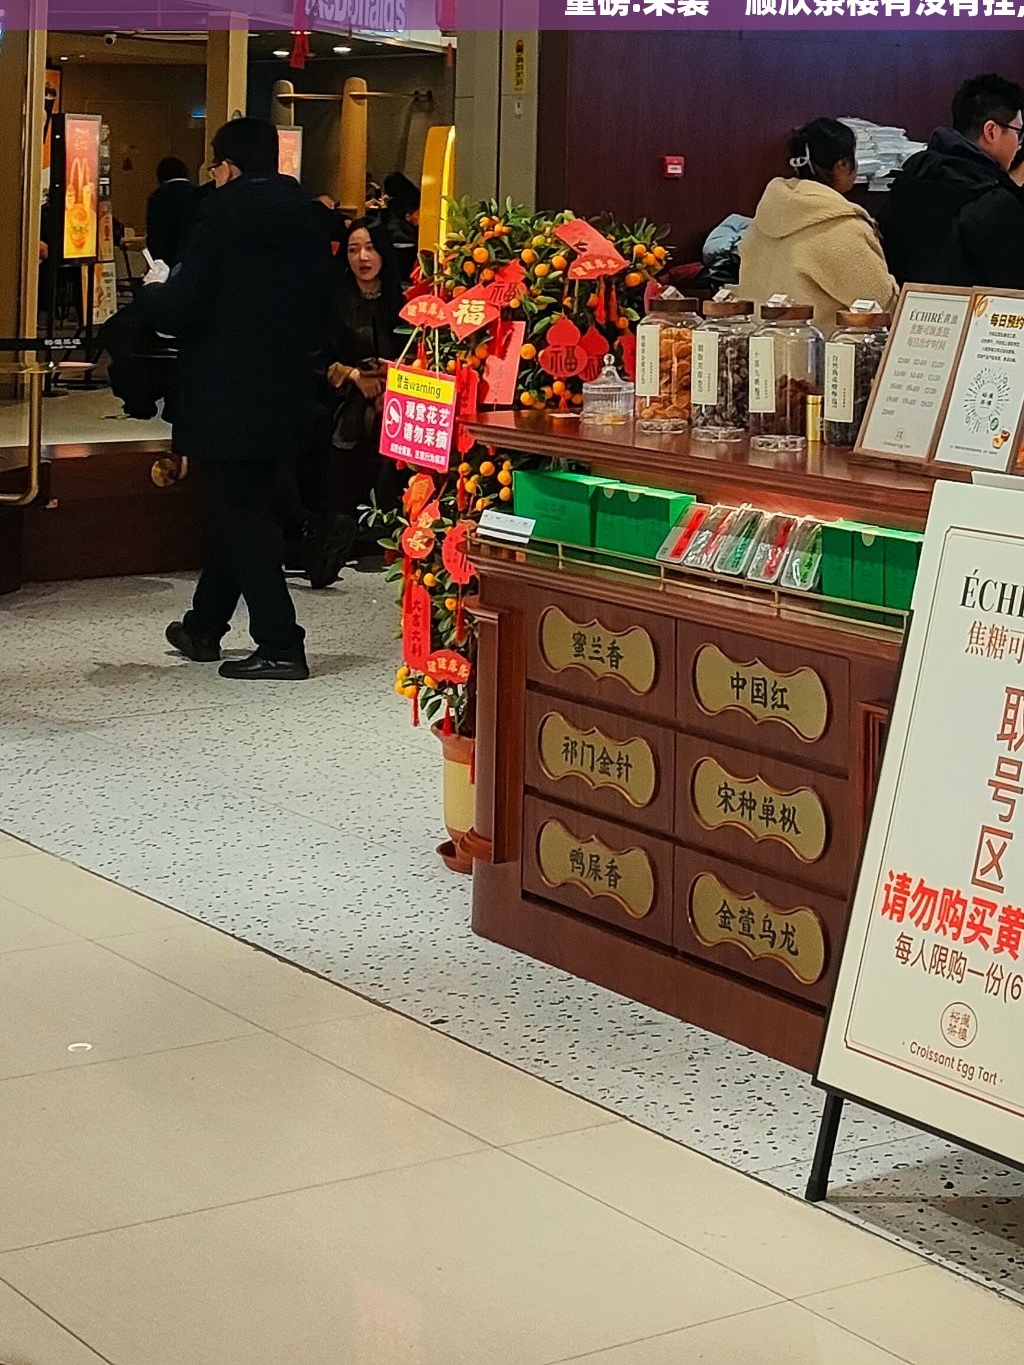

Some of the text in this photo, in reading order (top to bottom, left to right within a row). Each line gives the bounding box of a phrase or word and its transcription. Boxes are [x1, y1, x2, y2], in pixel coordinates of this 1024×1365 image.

[452, 298, 486, 325] 福
[550, 345, 578, 371] 福
[403, 422, 449, 450] 请勿采摘
[411, 599, 422, 657] 大吉大利
[572, 631, 623, 670] 蜜兰香
[730, 671, 790, 711] 中国红
[561, 736, 633, 783] 祁门金针
[717, 784, 801, 835] 宋种单枞
[569, 847, 622, 889] 鸭屎香
[715, 899, 799, 957] 金萱乌龙
[909, 1040, 998, 1086] Croissant Egg Tart
